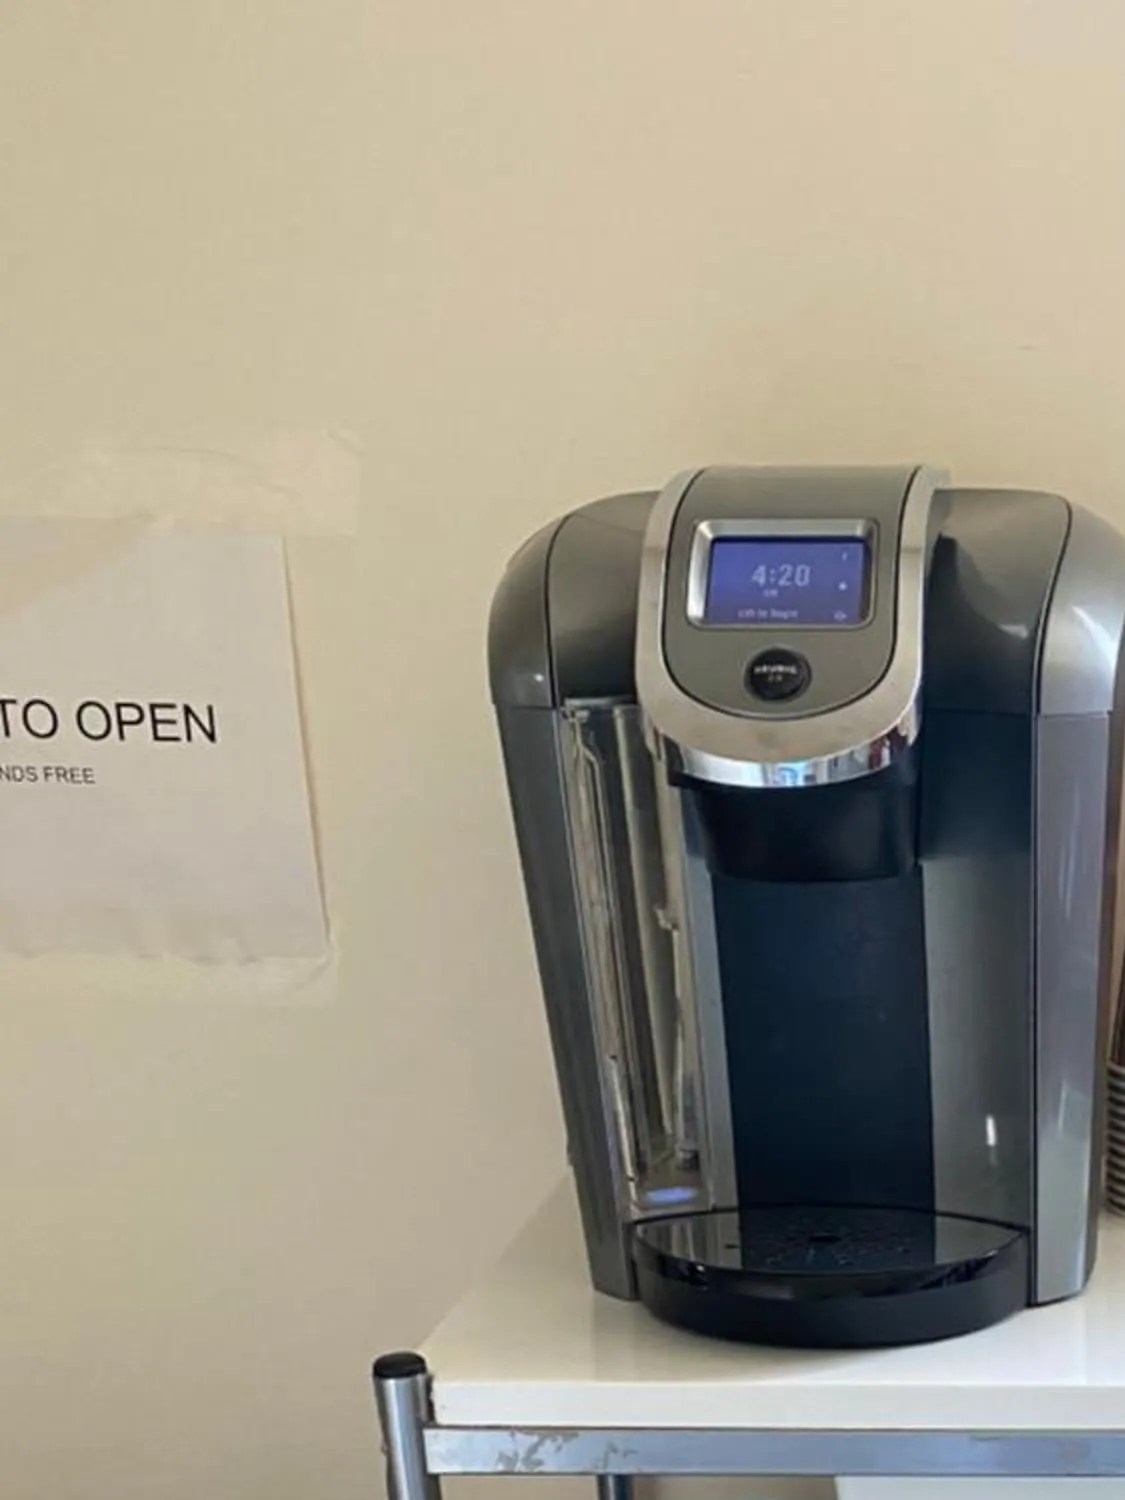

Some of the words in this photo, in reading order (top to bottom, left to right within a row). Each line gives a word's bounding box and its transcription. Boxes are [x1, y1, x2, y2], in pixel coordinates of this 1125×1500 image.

[751, 564, 811, 587] 4:20
[0, 698, 58, 739] TO
[75, 701, 216, 743] OPEN
[43, 766, 96, 784] FREE
